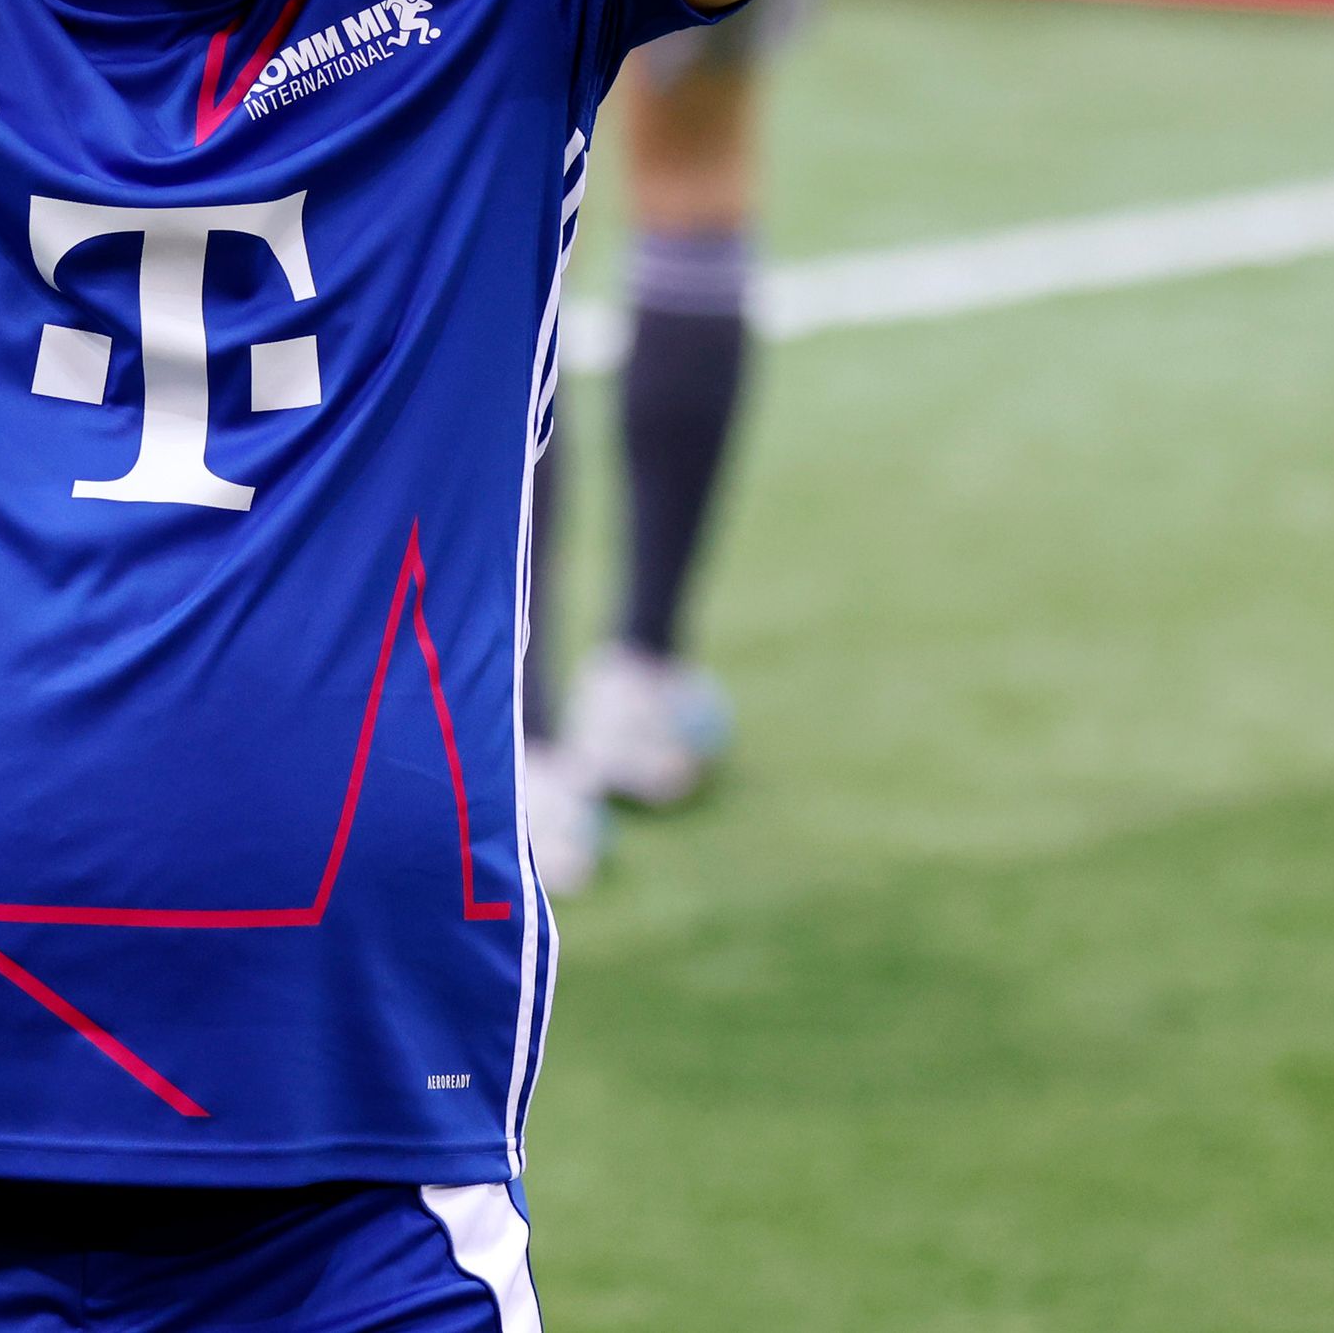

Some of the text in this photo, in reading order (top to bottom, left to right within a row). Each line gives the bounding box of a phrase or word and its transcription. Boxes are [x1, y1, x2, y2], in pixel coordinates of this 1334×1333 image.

[244, 39, 395, 121] INTERNATIONAL
[28, 189, 318, 512] T
[427, 1074, 471, 1090] AEROREADY
